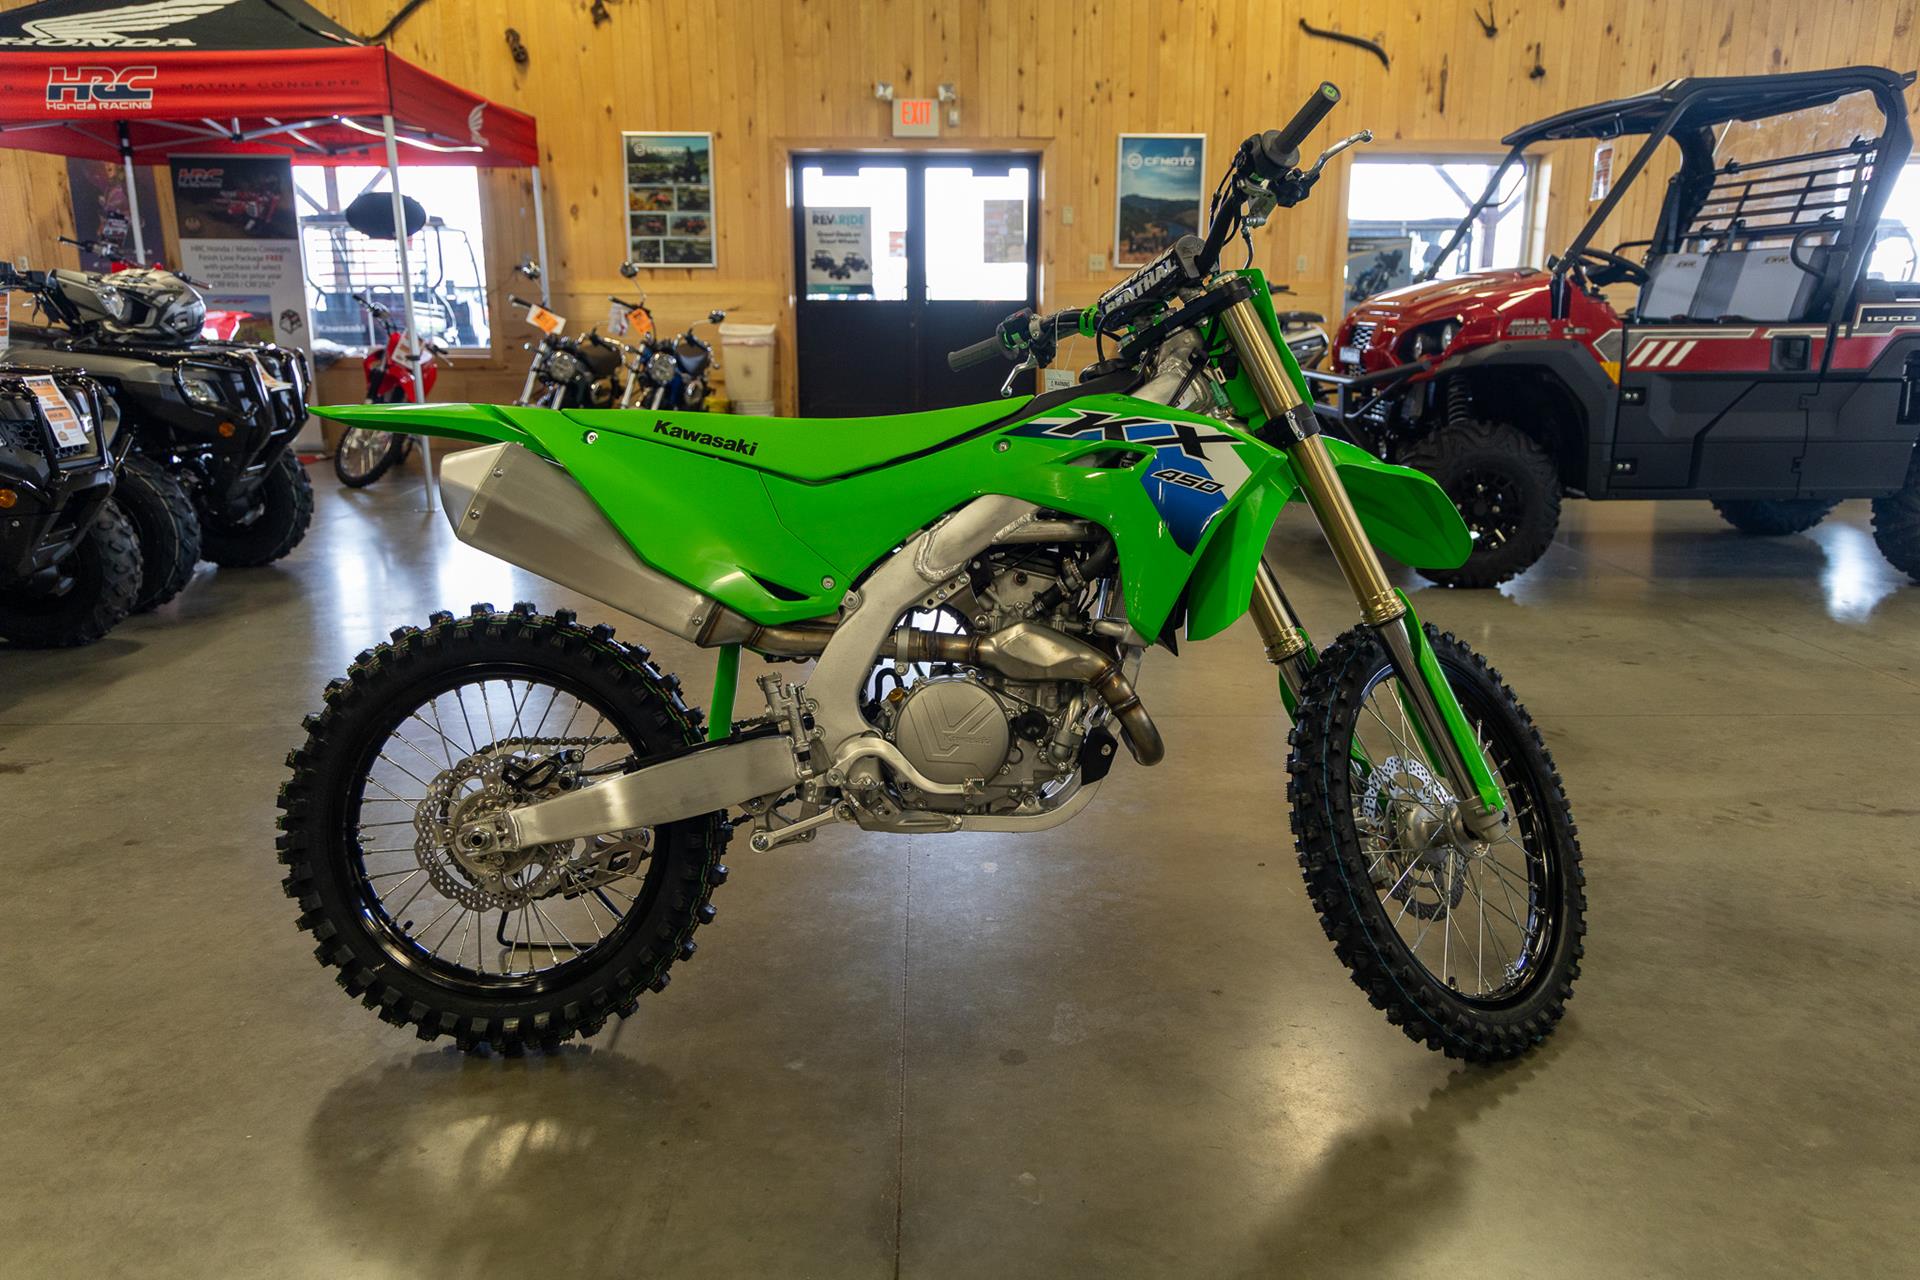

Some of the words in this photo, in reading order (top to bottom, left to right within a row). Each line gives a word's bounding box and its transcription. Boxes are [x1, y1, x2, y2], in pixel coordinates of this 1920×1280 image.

[0, 37, 197, 47] HONDA
[46, 66, 157, 102] HRC
[181, 83, 248, 91] MATRIX
[46, 101, 97, 111] Honda
[99, 101, 153, 110] RACING
[902, 101, 930, 125] EXIT
[1143, 156, 1196, 167] CFMOTO
[1103, 257, 1180, 315] RENTHAL
[653, 419, 759, 457] Kawasaki
[1151, 468, 1225, 494] 450
